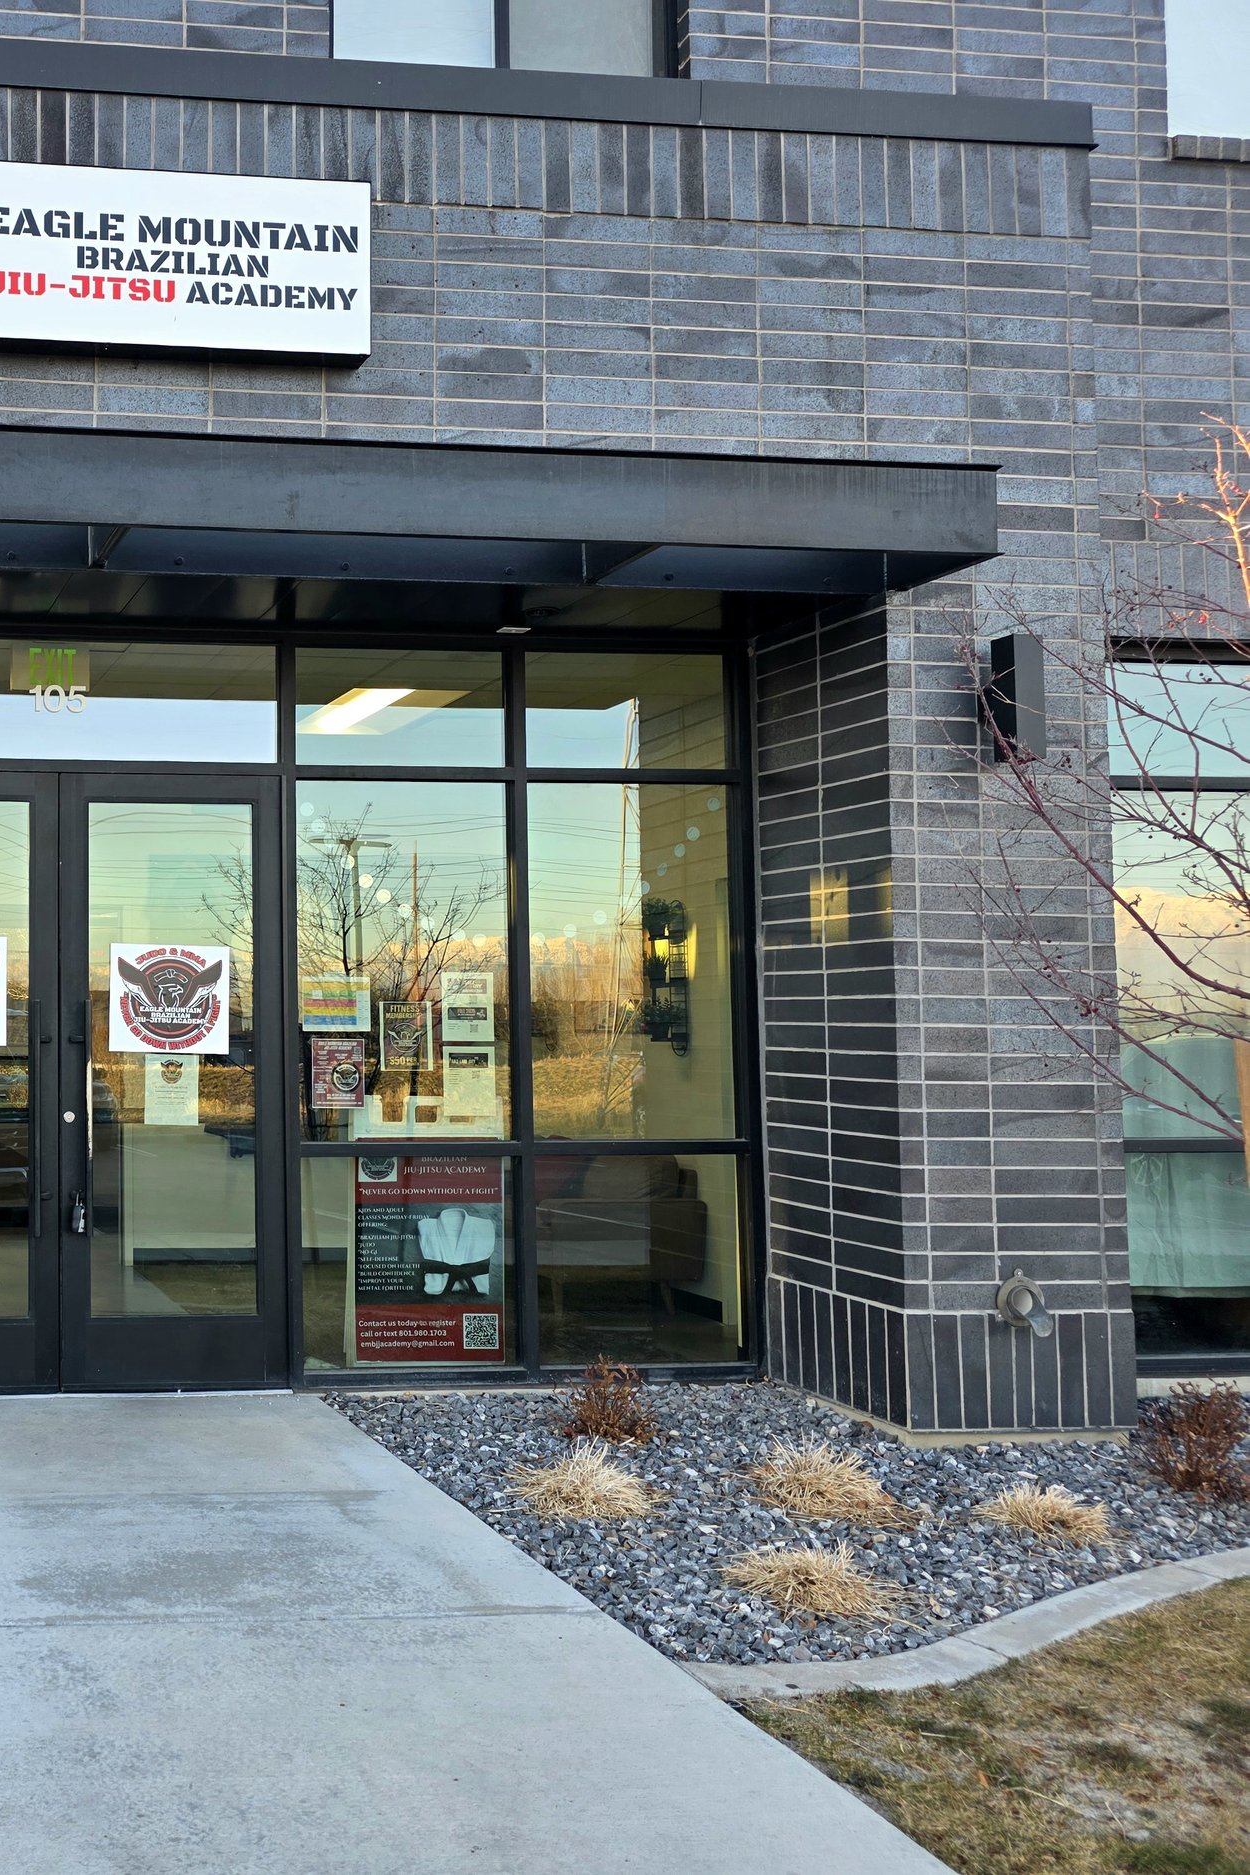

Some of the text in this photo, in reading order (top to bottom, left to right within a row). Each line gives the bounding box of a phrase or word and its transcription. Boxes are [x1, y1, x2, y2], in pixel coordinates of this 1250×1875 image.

[139, 215, 358, 253] MOUNTAIN
[77, 246, 269, 278] BRAZILIAN
[186, 281, 358, 310] ACADEMY
[30, 648, 77, 687] EXIT
[29, 684, 87, 713] 105
[135, 948, 206, 968] JUDO & MMA
[390, 1005, 420, 1013] FITNESS
[140, 1034, 167, 1050] DOWN
[204, 1025, 213, 1034] A
[390, 1056, 405, 1065] $50
[404, 1166, 486, 1175] JIU-JITSU ACADEMY
[427, 1187, 464, 1195] WITHOUT
[397, 1320, 418, 1328] today
[429, 1320, 456, 1328] register
[361, 1340, 455, 1349] embjjacademy@gmail.com
